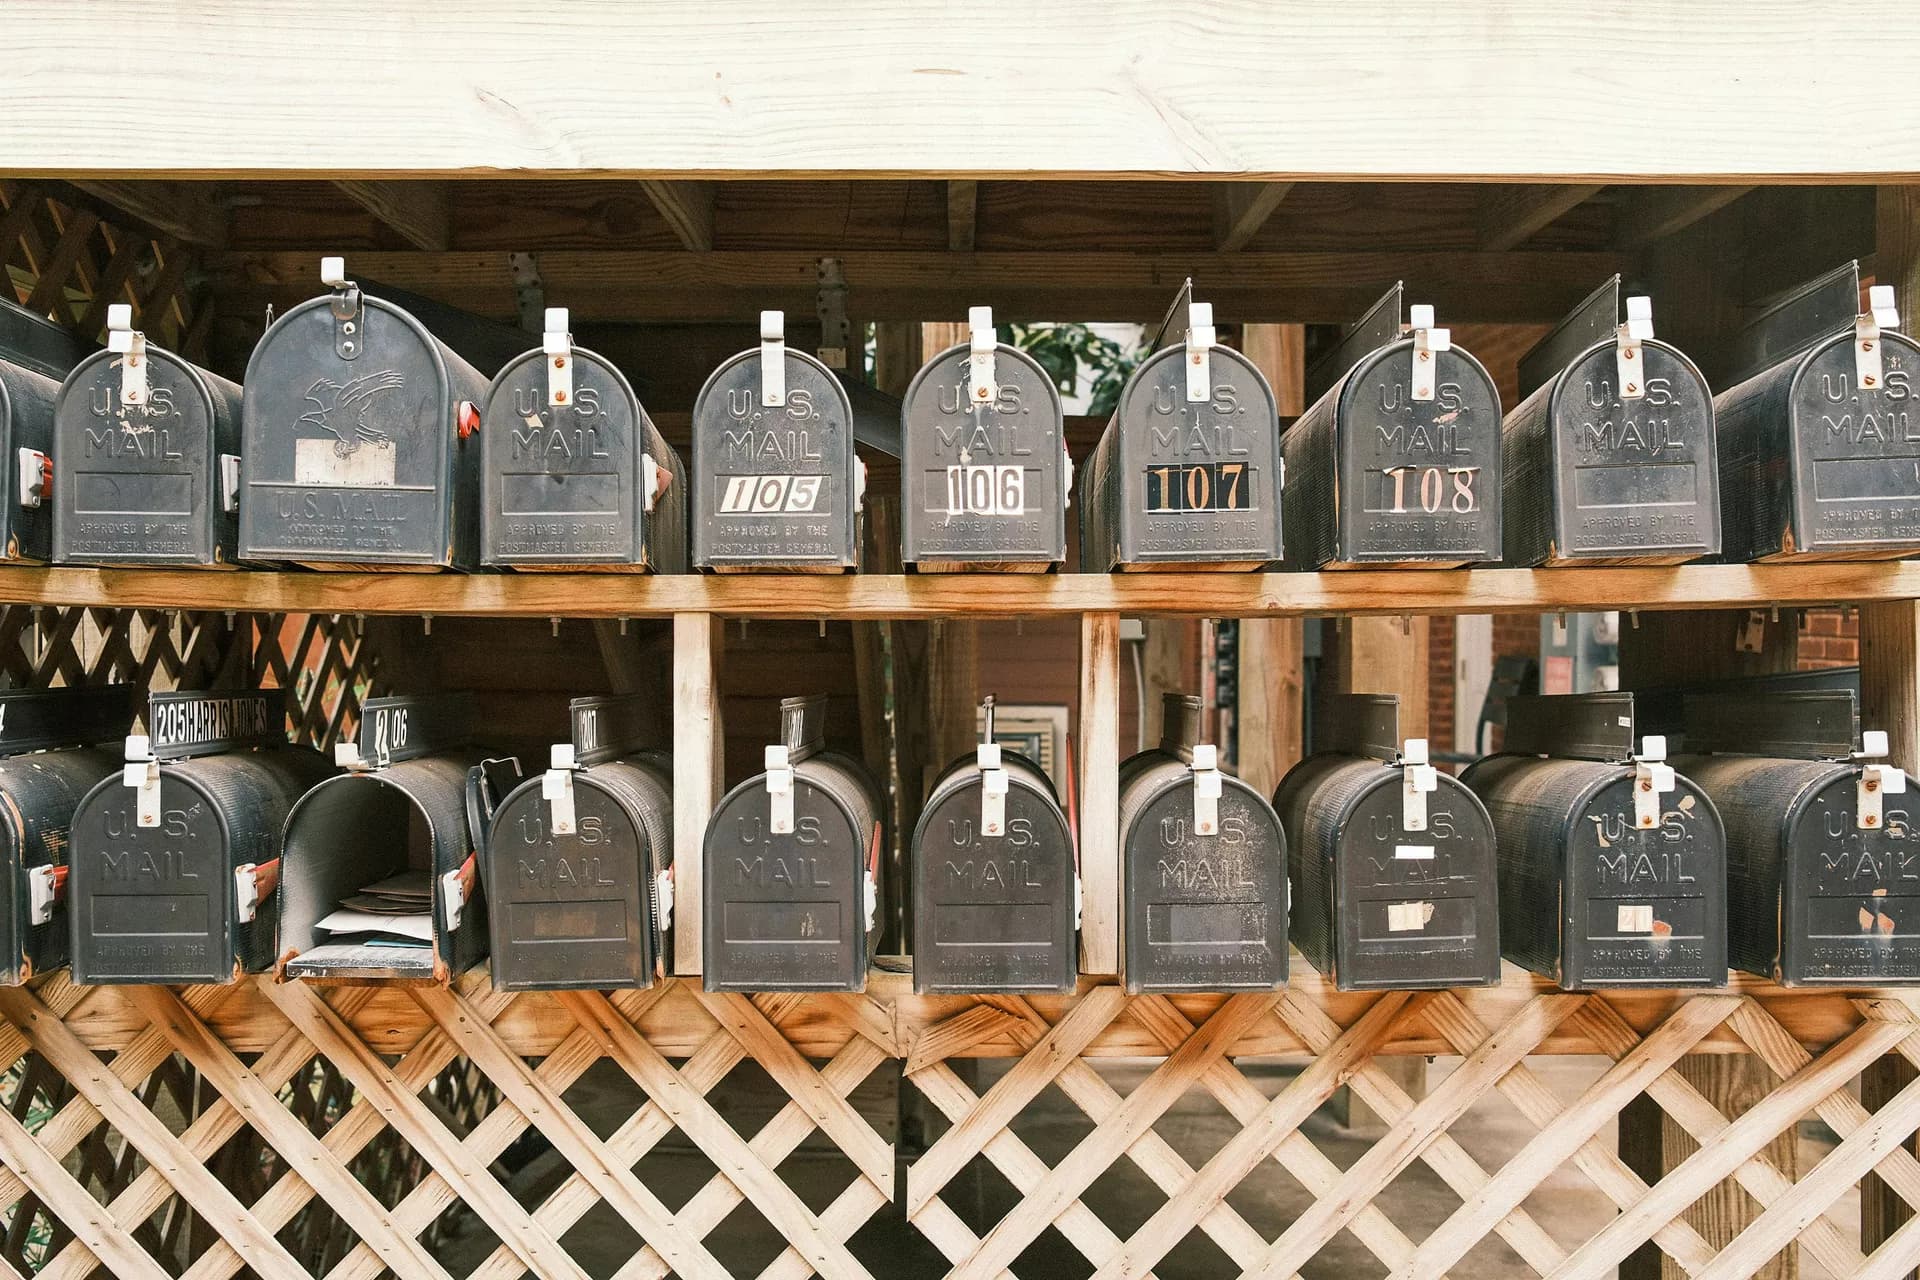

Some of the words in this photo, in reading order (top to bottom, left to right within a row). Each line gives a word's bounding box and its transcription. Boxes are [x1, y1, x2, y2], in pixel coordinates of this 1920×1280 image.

[85, 428, 183, 461] MAIL
[512, 429, 609, 460] MAIL
[935, 426, 1032, 456] MAIL
[1151, 426, 1248, 456] MAIL
[1376, 425, 1471, 456] MAIL
[1584, 420, 1684, 452] MAIL
[1822, 413, 1920, 445] MAIL
[725, 431, 821, 462] MAIL
[732, 478, 816, 511] 105
[950, 468, 1020, 510] 106
[1154, 464, 1243, 512] 107
[1385, 467, 1474, 513] 108
[100, 851, 198, 880] MAIL
[518, 857, 615, 888] MAIL
[735, 857, 831, 888] MAIL
[946, 860, 1041, 888] MAIL
[1158, 859, 1255, 888] MAIL
[1597, 853, 1695, 884] MAIL
[1820, 852, 1919, 882] MAIL
